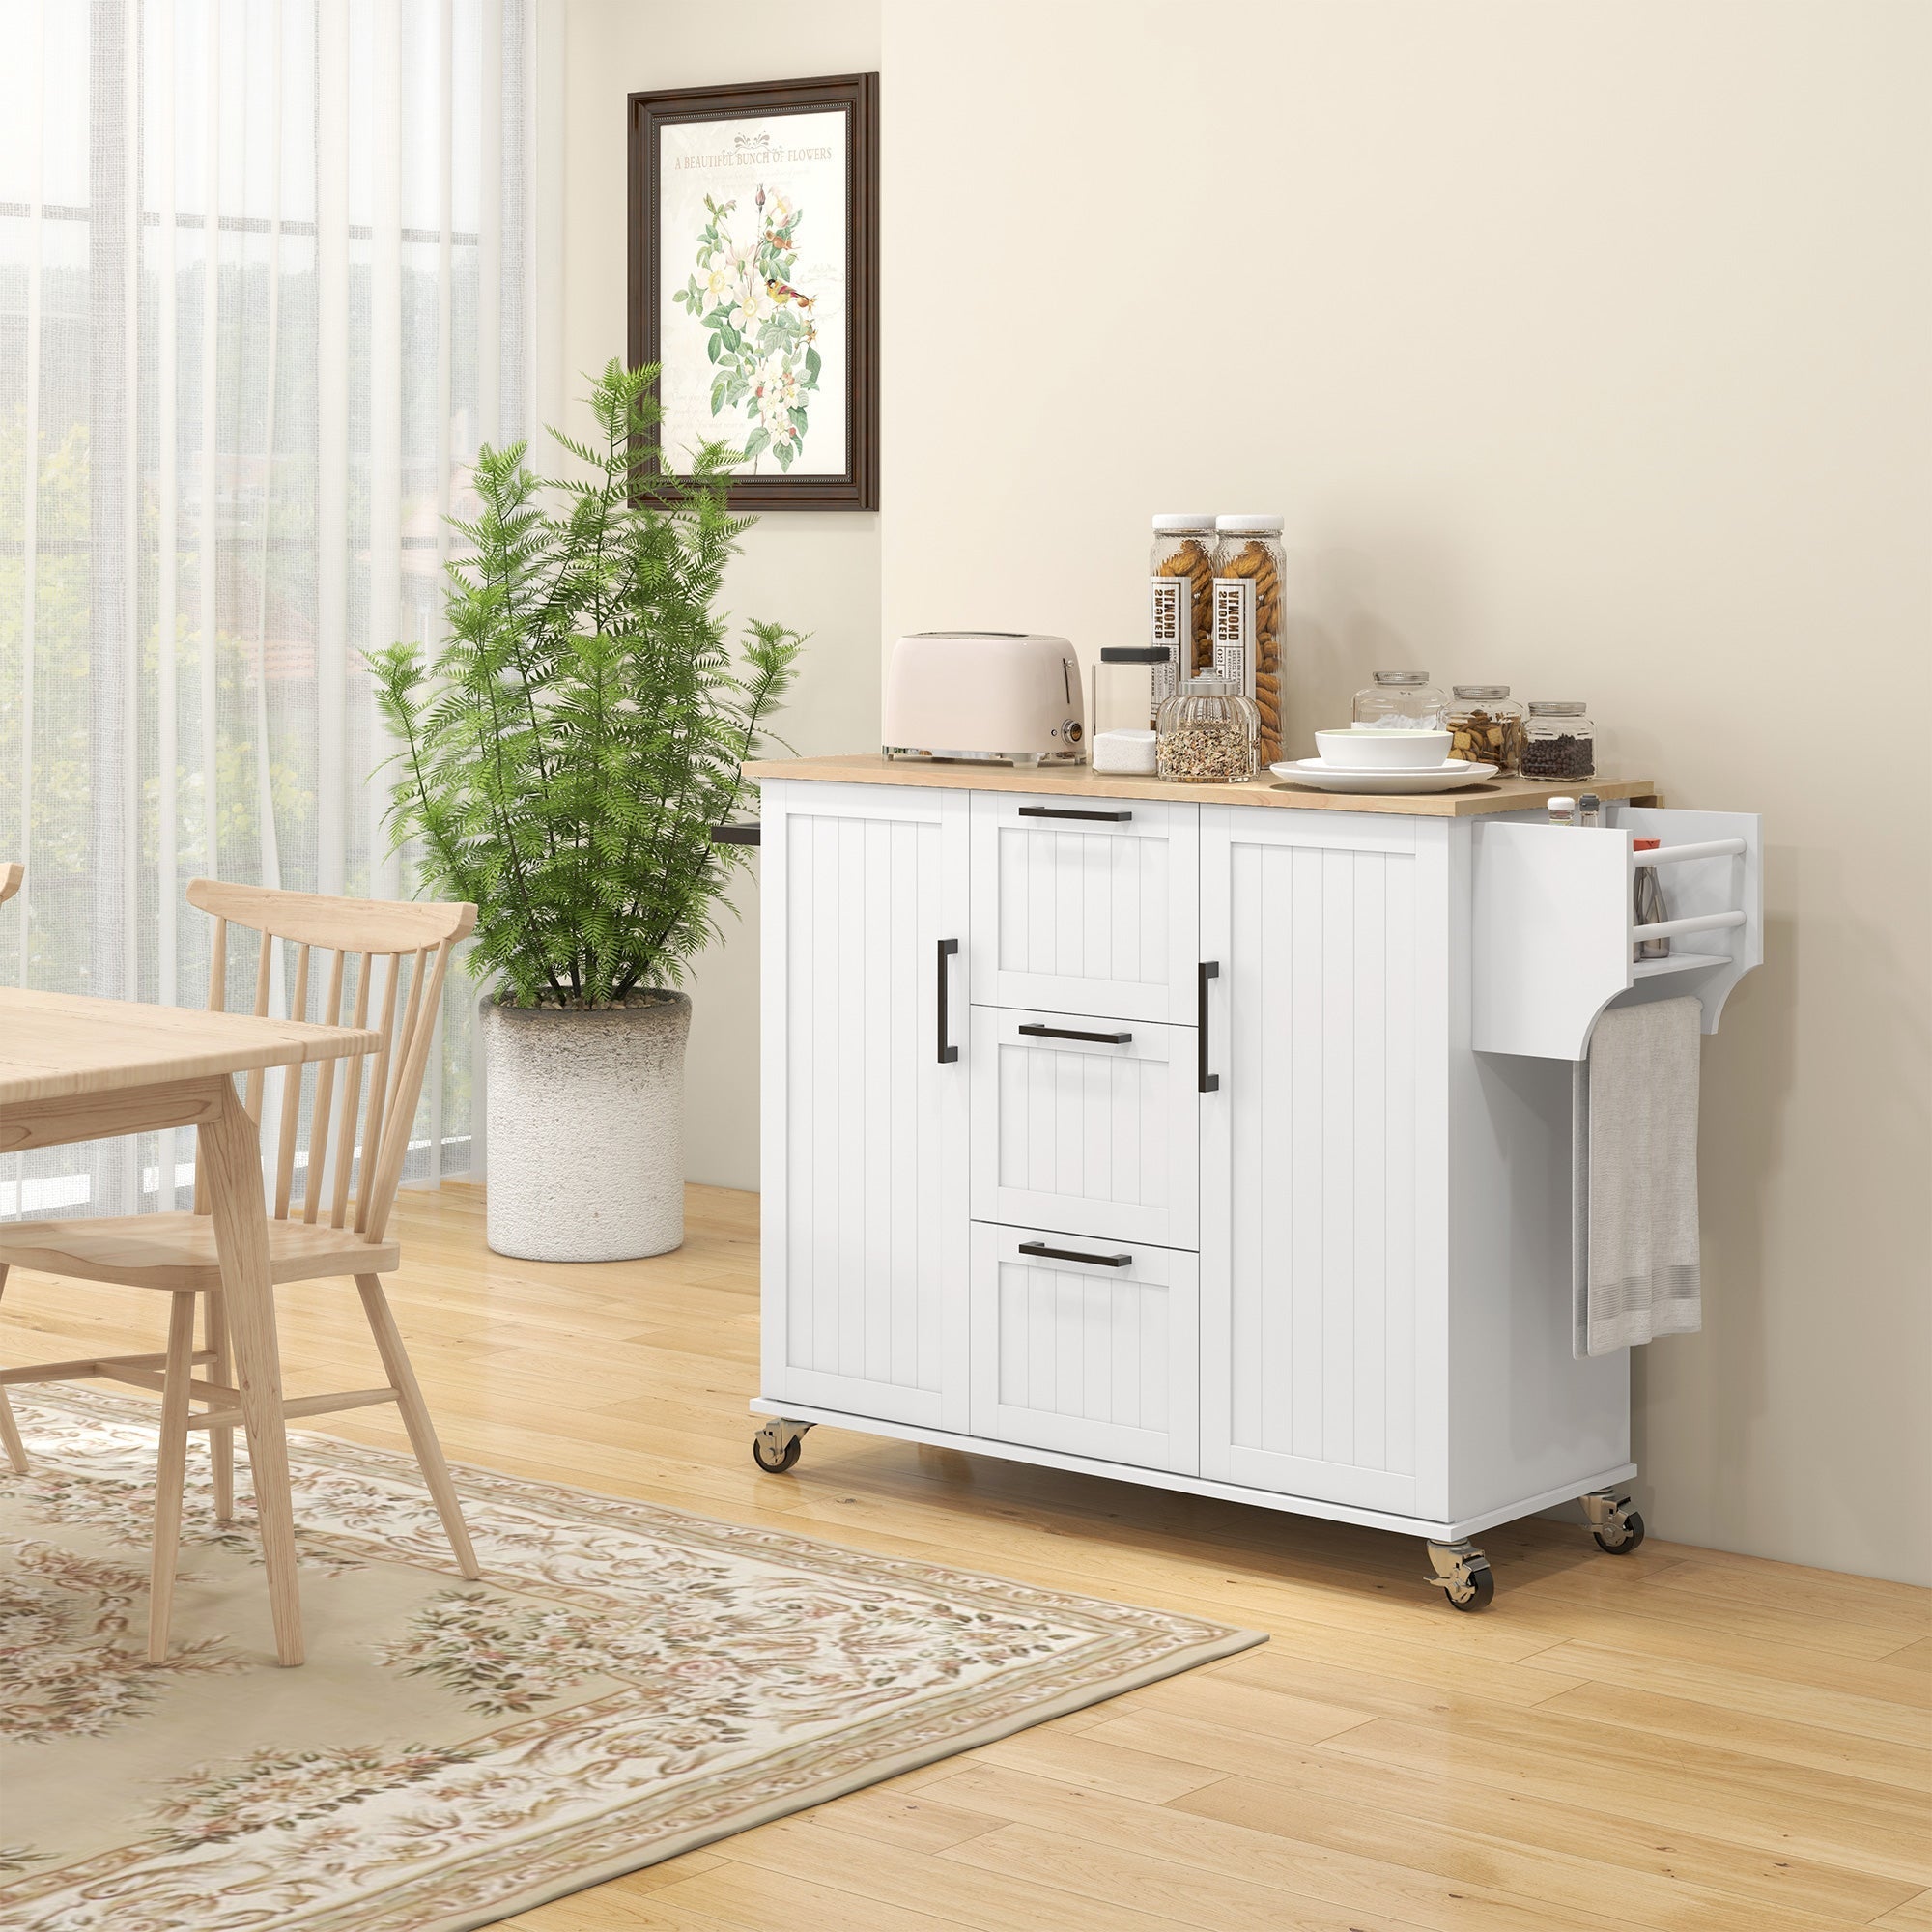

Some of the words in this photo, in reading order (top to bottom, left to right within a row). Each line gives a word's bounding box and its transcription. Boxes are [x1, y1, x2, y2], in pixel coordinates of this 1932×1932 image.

[675, 158, 681, 170] A
[684, 155, 734, 169] BEAUTIFUL
[737, 152, 770, 165] BUNCH
[773, 150, 785, 162] OF
[788, 147, 833, 161] FLOWERS
